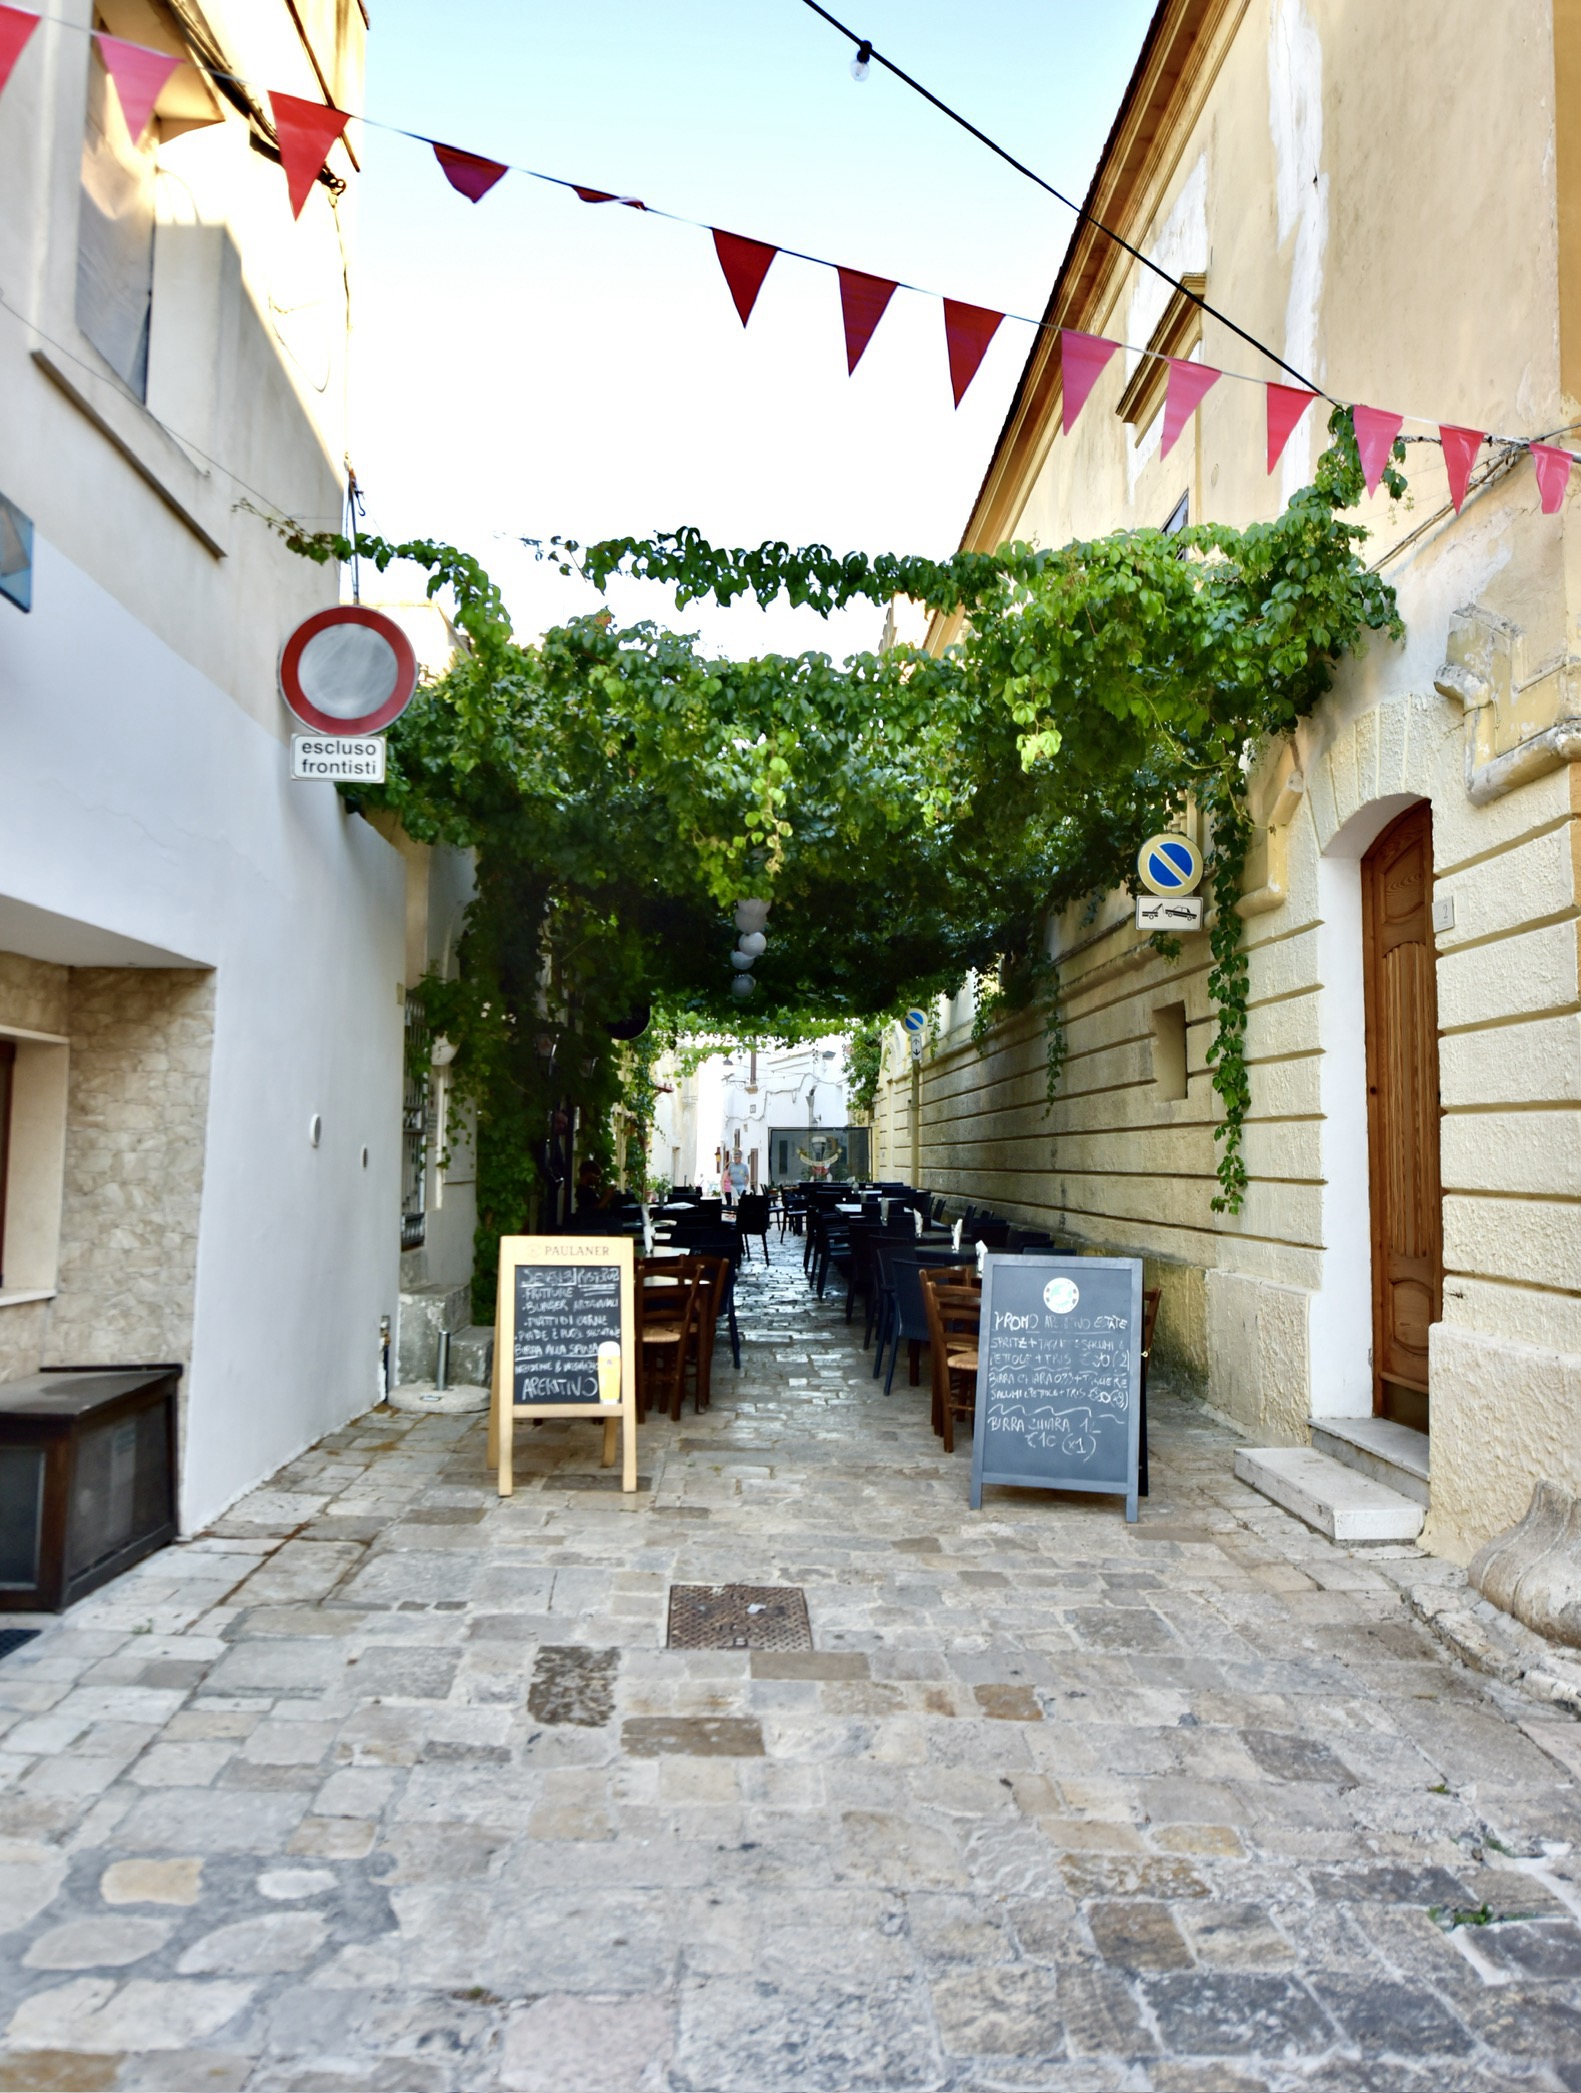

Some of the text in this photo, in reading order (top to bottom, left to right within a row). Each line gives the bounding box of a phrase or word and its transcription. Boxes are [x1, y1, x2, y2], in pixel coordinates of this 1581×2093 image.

[302, 740, 376, 756] escluso
[302, 758, 377, 775] frontisti
[1442, 903, 1449, 919] 2
[545, 1245, 609, 1257] PAULANER
[1094, 1314, 1128, 1329] ESTATE
[988, 1416, 1025, 1432] BIRRA
[1028, 1417, 1071, 1433] CHIARA
